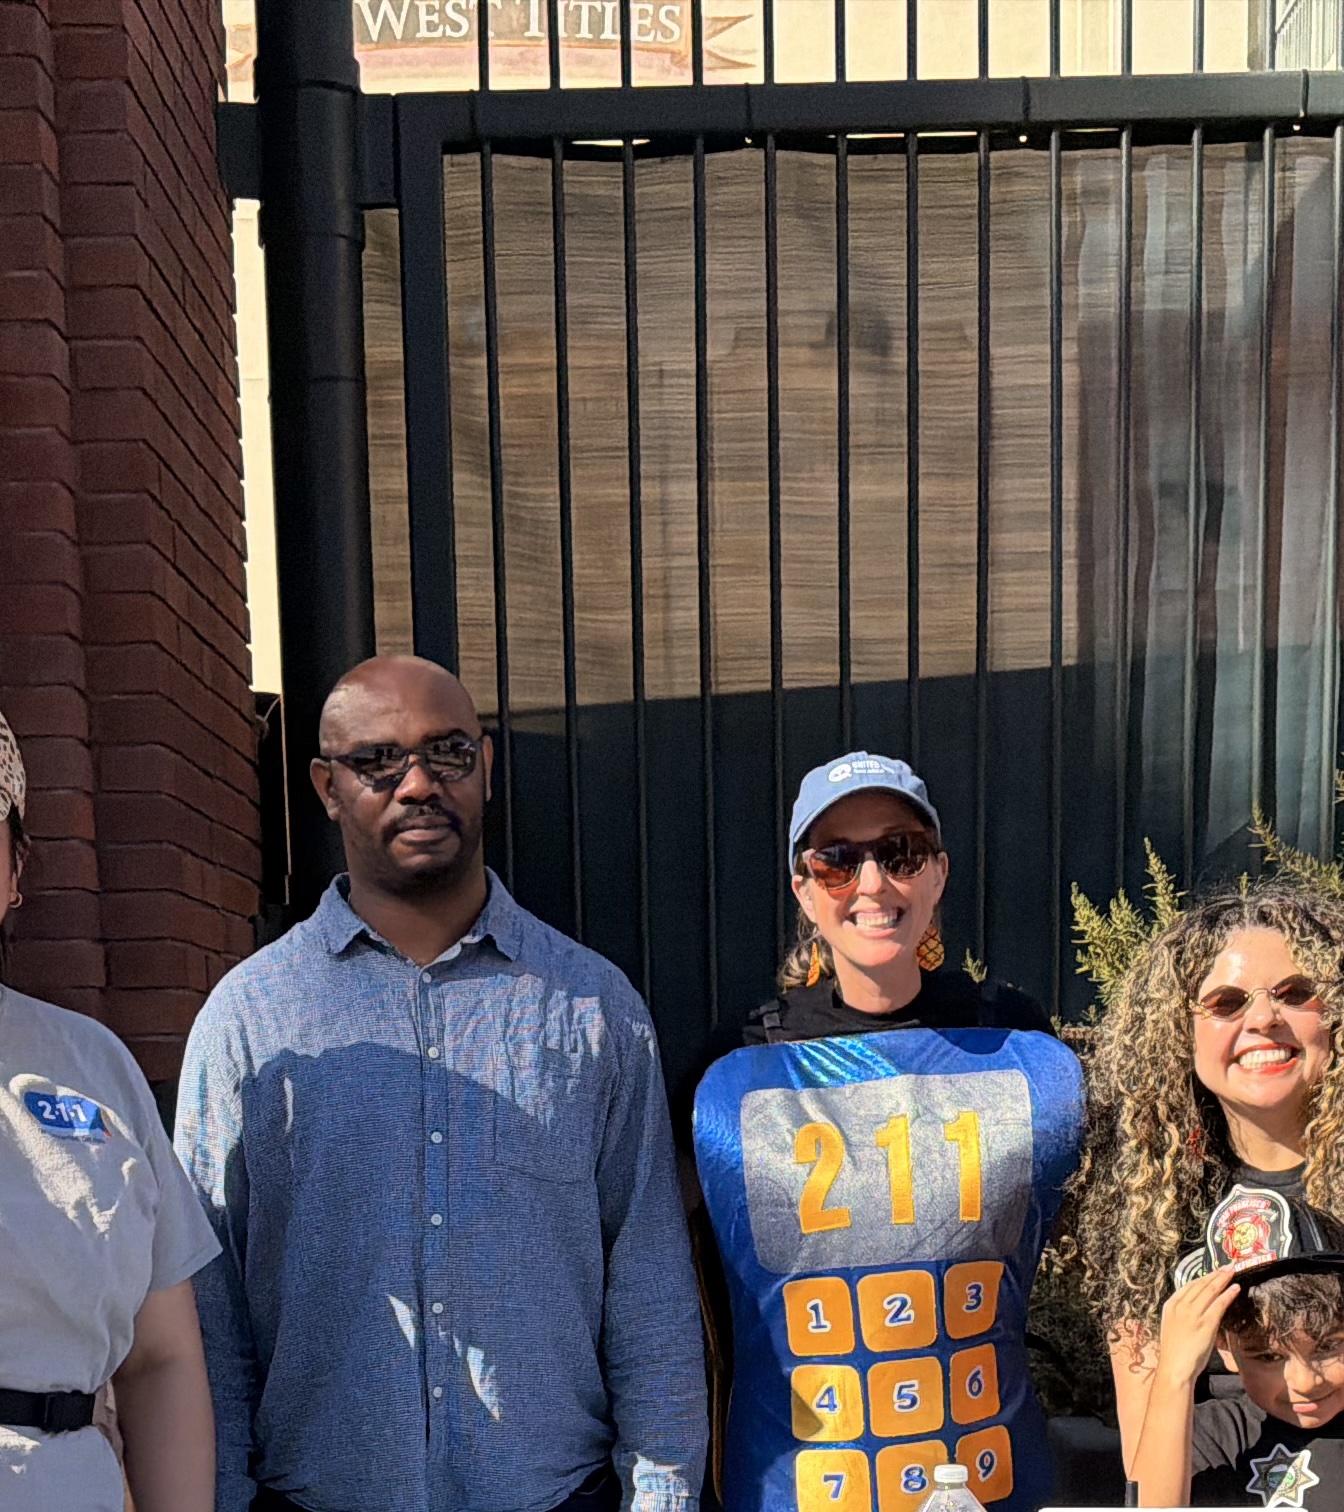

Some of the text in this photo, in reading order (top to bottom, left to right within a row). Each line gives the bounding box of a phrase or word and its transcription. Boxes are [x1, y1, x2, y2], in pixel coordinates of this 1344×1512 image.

[793, 1110, 983, 1235] 211
[806, 1281, 984, 1334] 1 2 3
[815, 1366, 984, 1414] 4 5 6
[822, 1449, 998, 1502] 7 8 9
